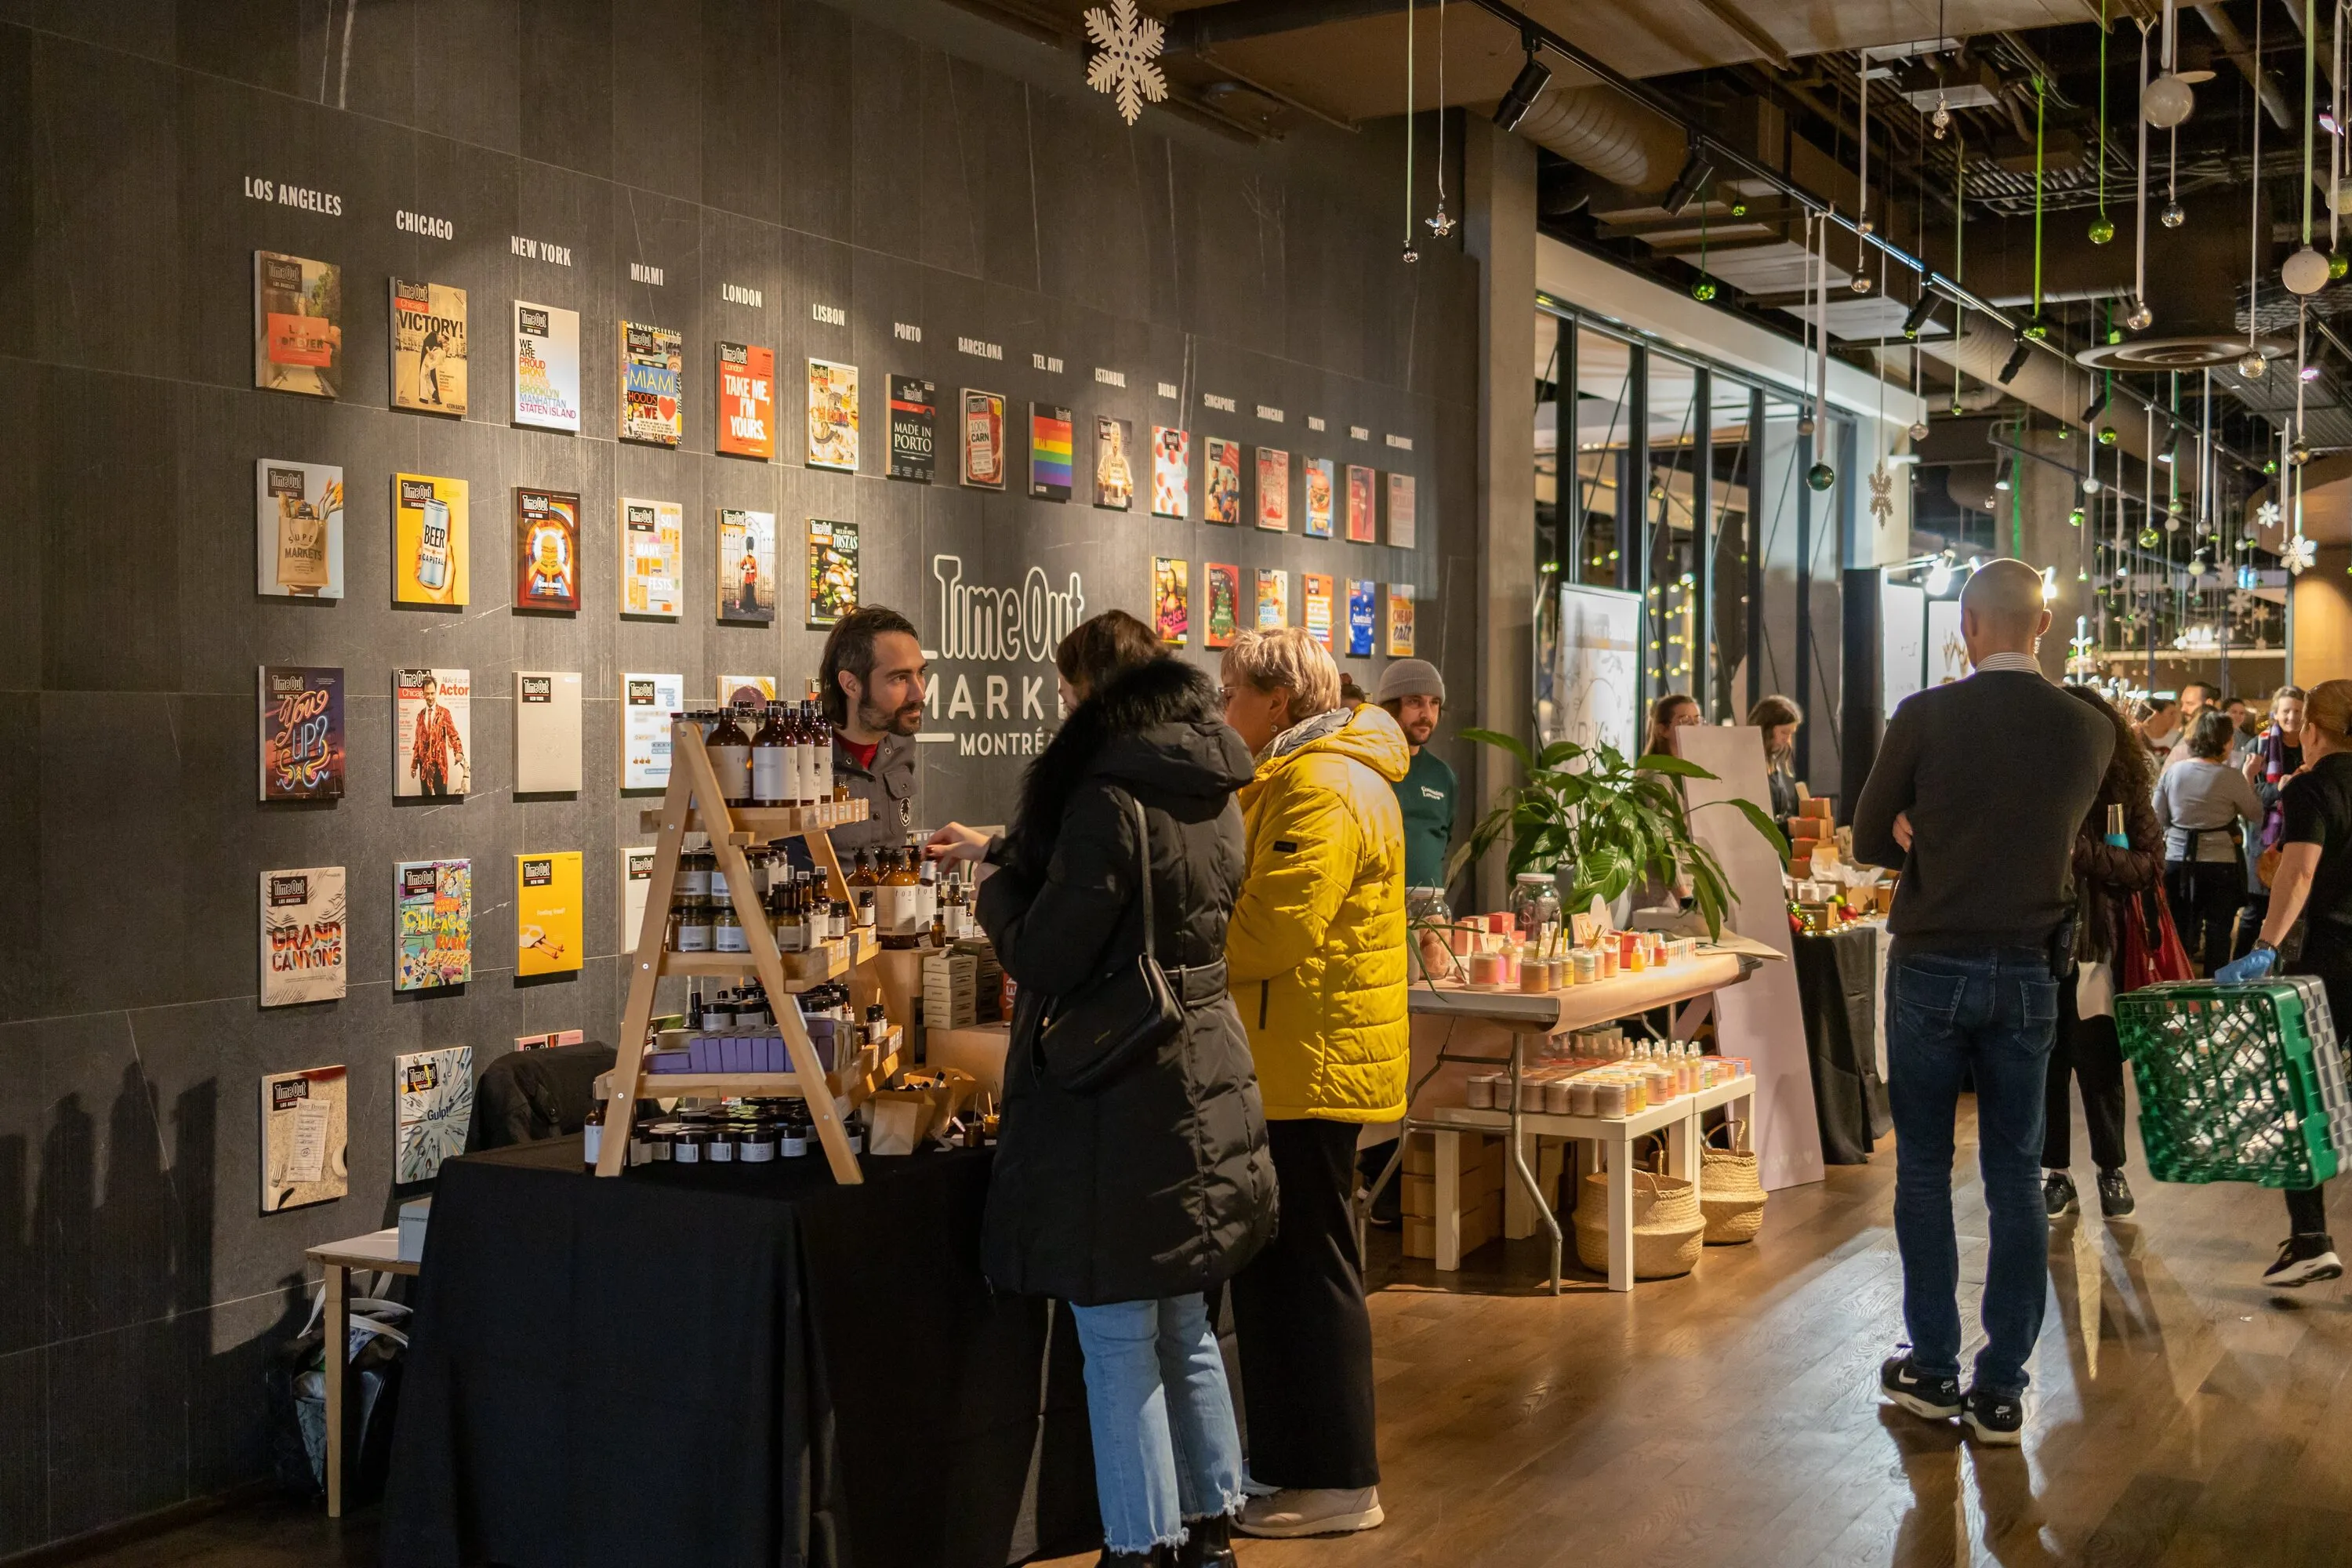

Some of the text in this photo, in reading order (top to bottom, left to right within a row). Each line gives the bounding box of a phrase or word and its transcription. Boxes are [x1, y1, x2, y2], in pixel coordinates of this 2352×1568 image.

[245, 176, 342, 216] LOS ANGELES
[396, 209, 453, 241] CHICAGO
[511, 235, 572, 267] NEW YORK
[630, 263, 664, 287] MIAMI
[722, 283, 762, 308] LONDON
[812, 303, 845, 326] LISBON
[397, 311, 464, 339] VICTORY!
[894, 322, 921, 343] PORTO
[519, 338, 533, 350] WE
[519, 348, 535, 359] ARE
[958, 336, 1003, 361] BARCELONA
[519, 357, 546, 370] PROUD
[519, 366, 546, 379] BRONX
[724, 362, 745, 374] London
[1033, 354, 1064, 374] TEL AVIV
[630, 368, 674, 394] MIAMI
[1094, 367, 1127, 388] ISTANBUL
[519, 385, 560, 398] BROOKLYN
[628, 391, 658, 406] HOODS
[724, 374, 771, 406] TAKE ME,
[1157, 381, 1178, 400] DUBAI
[519, 394, 567, 408] MANHATTAN
[519, 402, 576, 419] STATEN ISLAND
[739, 396, 756, 419] I'M
[1203, 393, 1236, 413] SINGAPORE
[730, 416, 768, 441] YOURS.
[894, 422, 932, 438] MADE IN
[970, 420, 989, 433] 100%
[894, 433, 932, 453] PORTO
[288, 532, 320, 544] SUPER
[423, 524, 445, 549] BEER
[833, 535, 858, 550] TOSTAS
[284, 547, 322, 561] MARKETS
[422, 554, 445, 566] CAPITAL
[401, 688, 424, 699] Chicag
[439, 683, 470, 696] Actor
[292, 715, 328, 760] UP?
[960, 726, 1056, 757] MONTRÉ
[404, 910, 467, 935] CHICAGO
[271, 921, 342, 952] GRAND
[271, 946, 342, 973] CANYONS
[428, 950, 470, 967] BETTER
[426, 1105, 449, 1123] Gulp!
